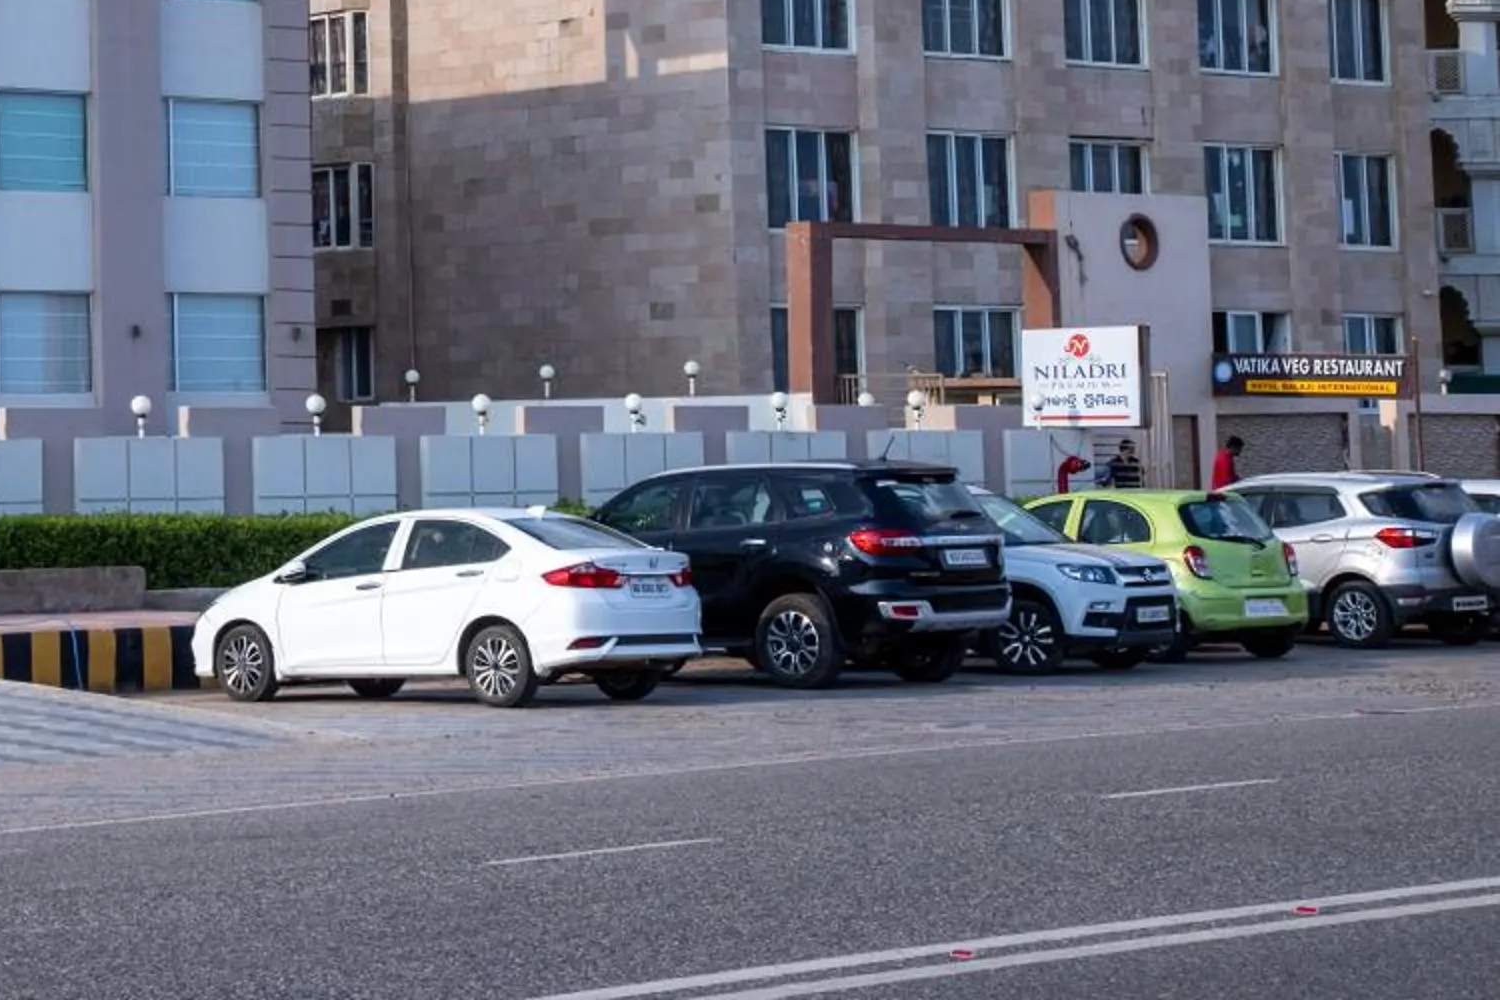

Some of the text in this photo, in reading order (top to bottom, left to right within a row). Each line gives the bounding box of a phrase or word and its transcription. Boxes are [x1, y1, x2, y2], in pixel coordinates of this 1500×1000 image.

[1034, 363, 1127, 380] NILADRI
[1232, 357, 1405, 377] VATIKA VEG RESTAURANT
